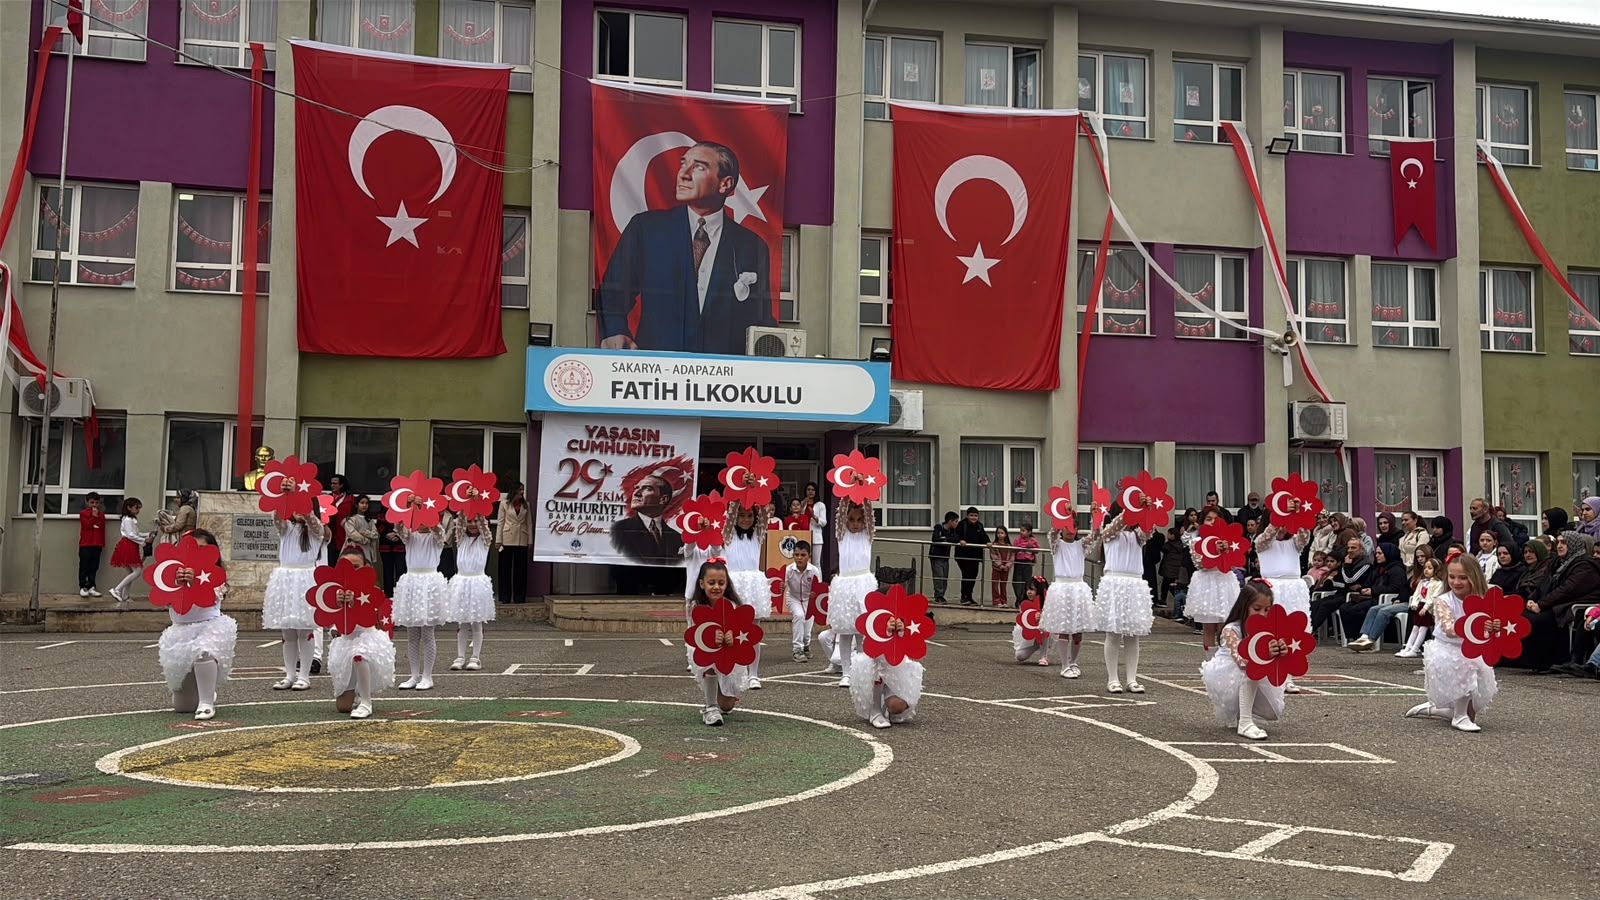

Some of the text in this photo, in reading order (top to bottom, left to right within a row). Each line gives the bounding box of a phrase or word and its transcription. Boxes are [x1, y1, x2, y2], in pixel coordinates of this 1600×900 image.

[611, 361, 662, 374] SAKARYA
[672, 364, 734, 377] ADAPAZARI
[611, 378, 678, 401] FATİH
[685, 378, 802, 404] İLKOKULU
[585, 425, 661, 442] YAŞASIN
[567, 438, 675, 457] CUMHURİYET!
[553, 457, 624, 502] 29 EKİM
[546, 500, 626, 516] CUMHURİYET
[548, 512, 616, 522] BAYRAMIMIZ
[549, 520, 575, 536] Kutlu
